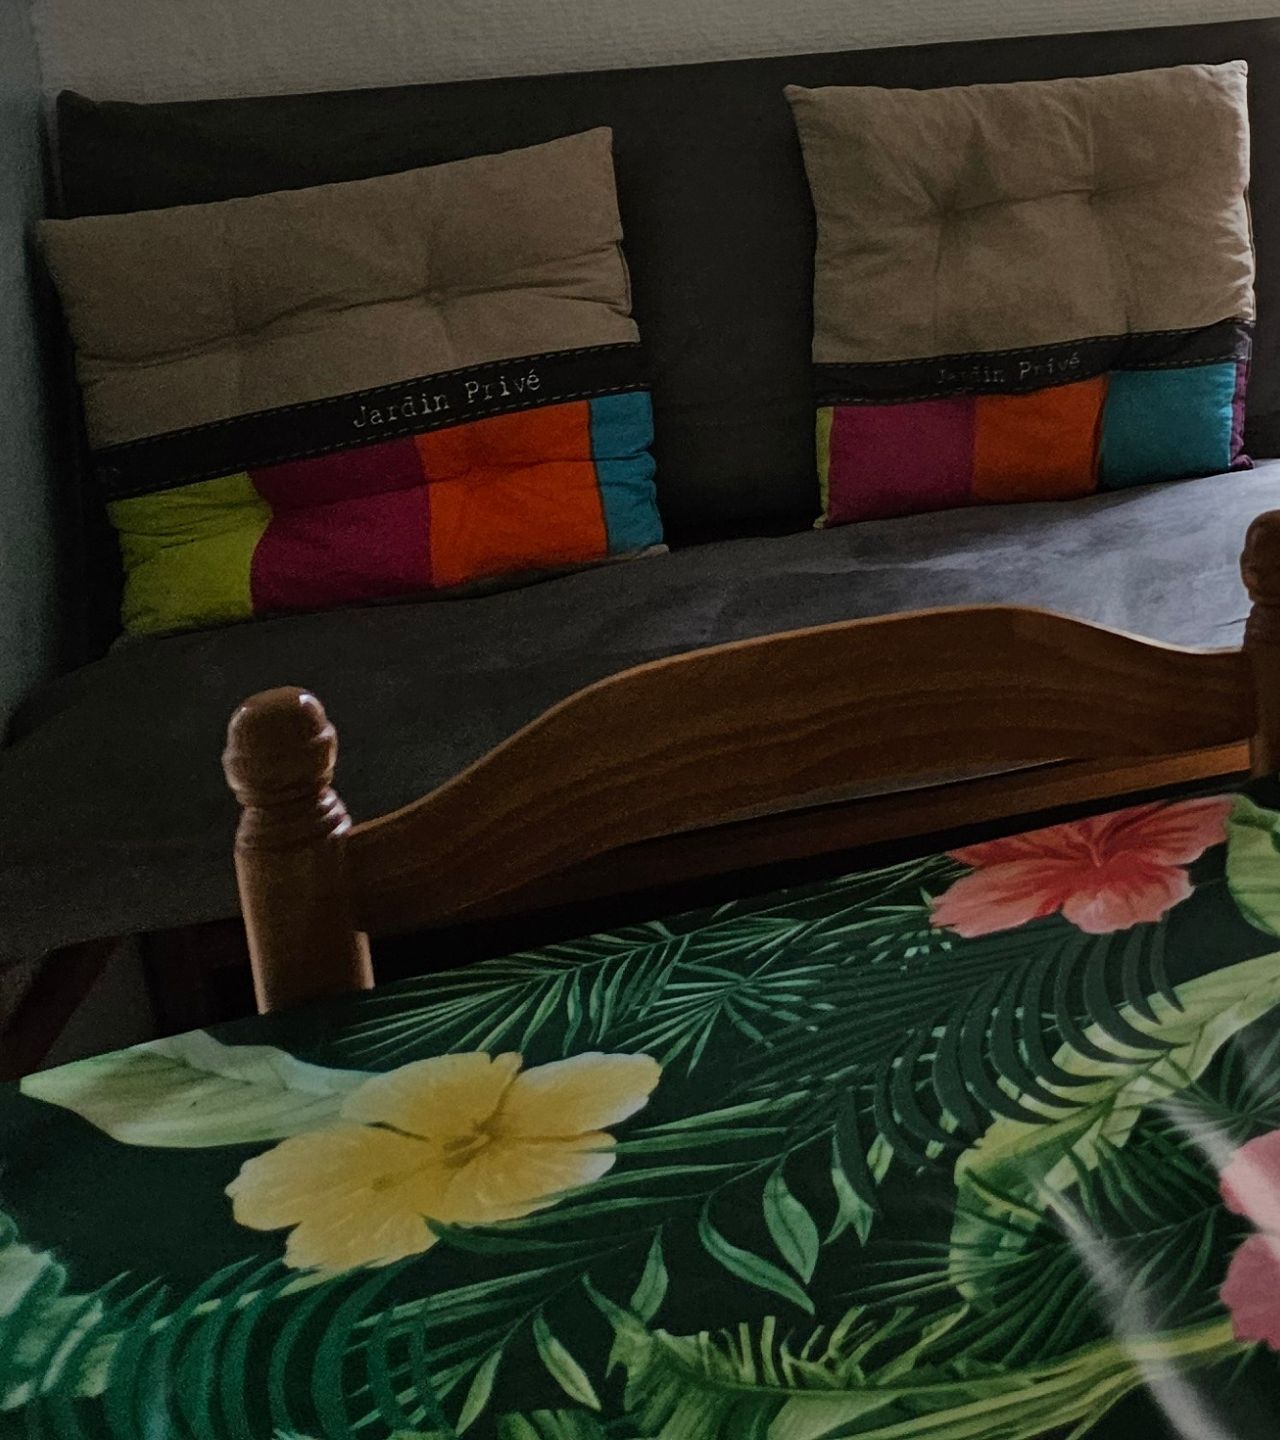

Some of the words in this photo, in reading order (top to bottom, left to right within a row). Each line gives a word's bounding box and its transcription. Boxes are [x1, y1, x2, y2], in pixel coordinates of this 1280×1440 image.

[1019, 352, 1081, 382] Privé
[353, 393, 450, 428] Jardin
[464, 369, 541, 403] Privé
